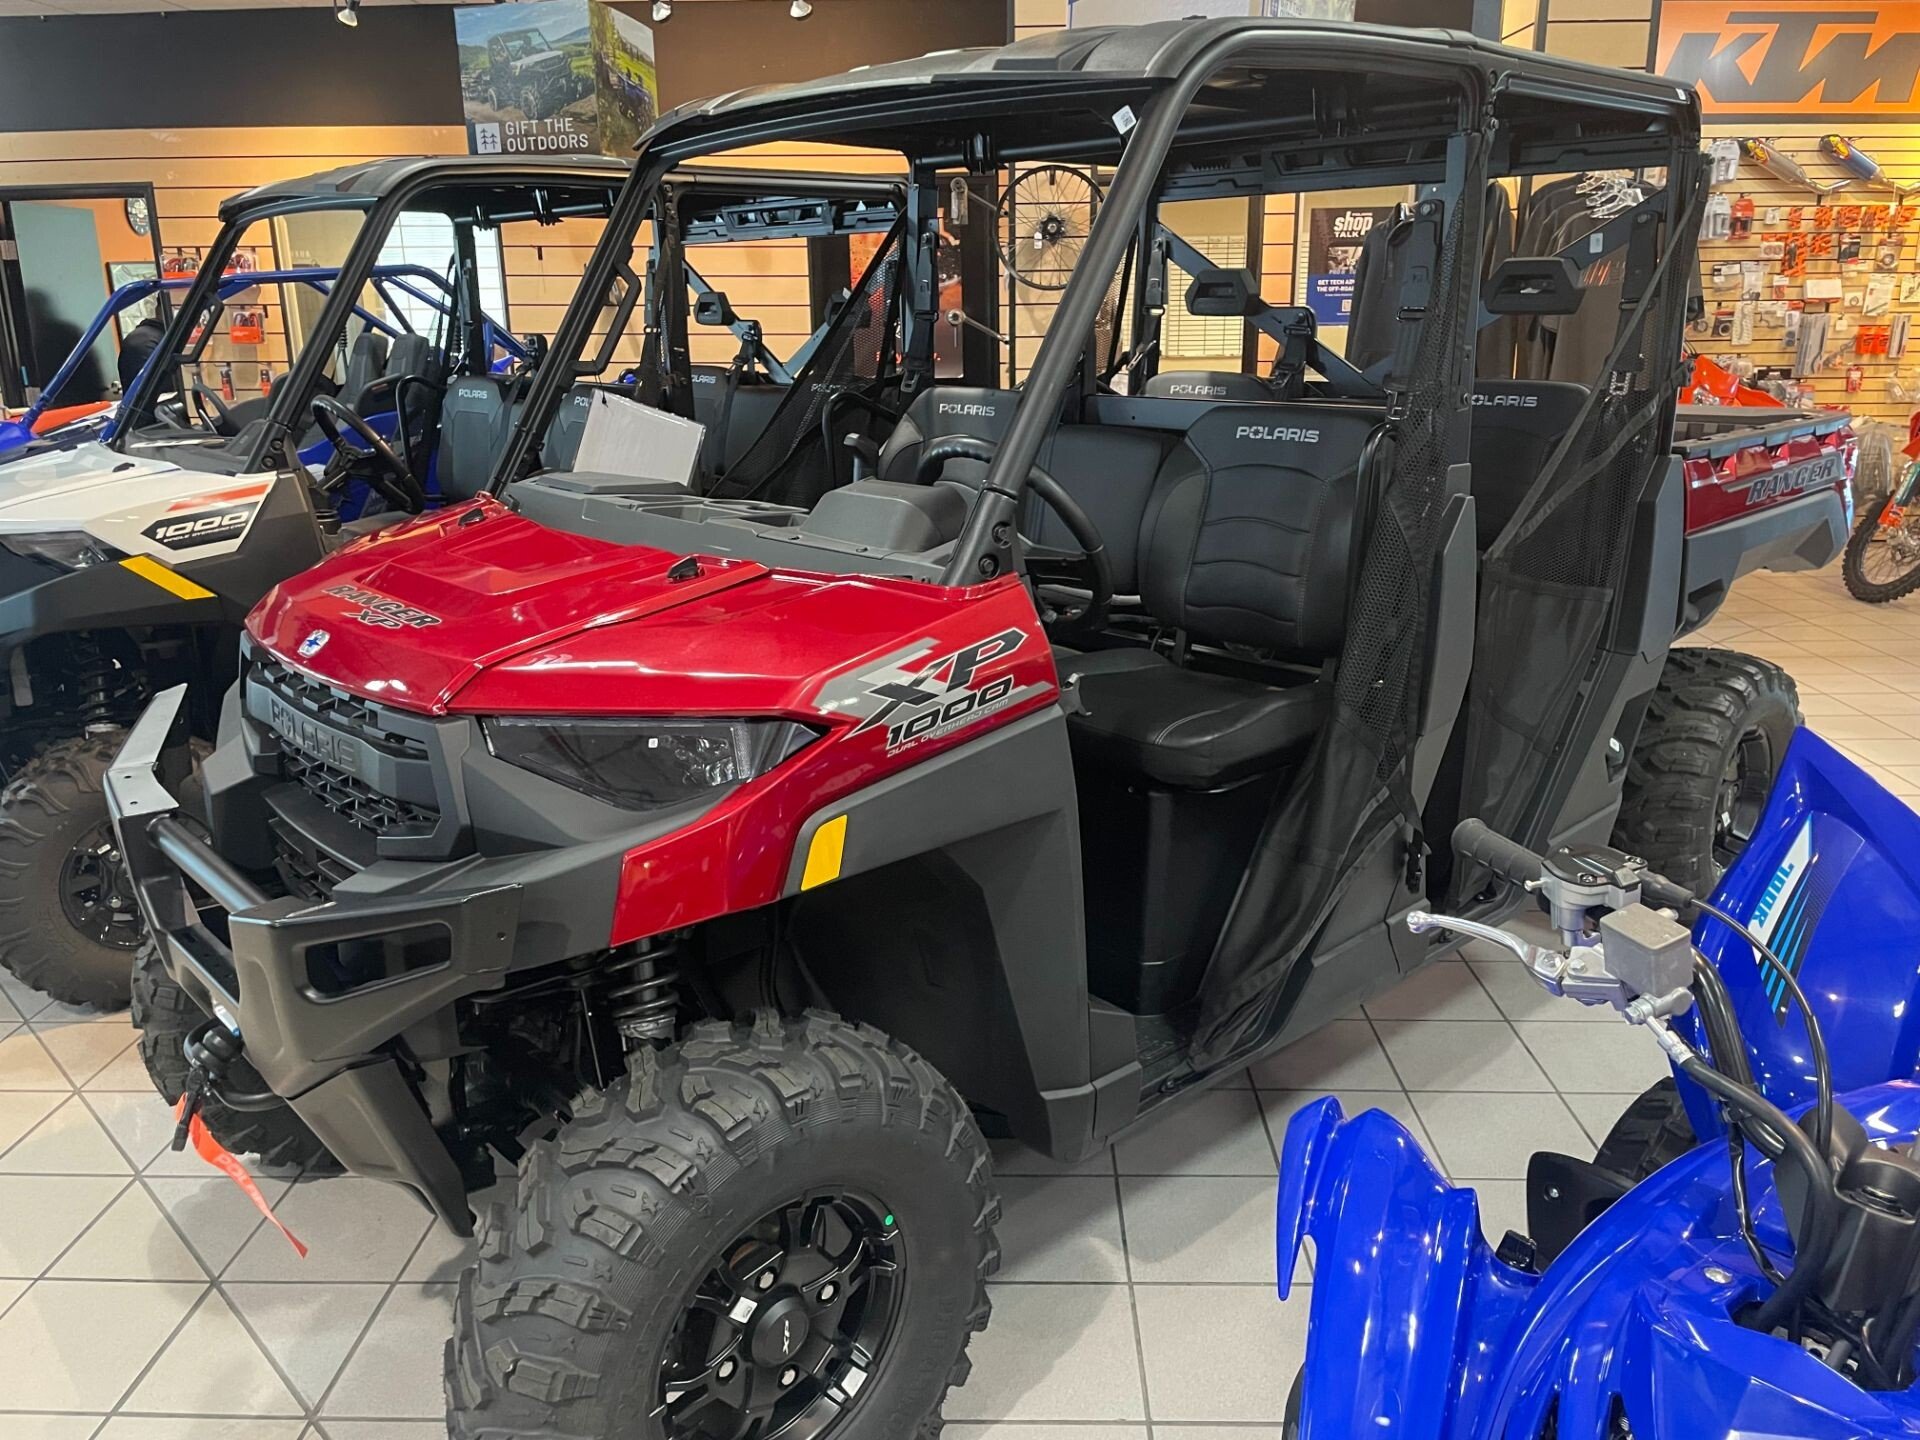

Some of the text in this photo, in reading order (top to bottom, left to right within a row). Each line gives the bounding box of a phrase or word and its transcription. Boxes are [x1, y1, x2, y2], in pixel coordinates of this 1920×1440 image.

[1663, 11, 1920, 103] KTM
[505, 118, 574, 136] GIFT THE
[506, 133, 589, 152] OUTDOORS
[1333, 211, 1373, 235] shop
[691, 376, 717, 384] OLARIS
[1169, 384, 1228, 396] POLARIS
[458, 388, 488, 399] POLARIS
[1471, 394, 1538, 407] OLARIS
[939, 403, 996, 417] POLARIS
[1235, 426, 1320, 443] POLARIS
[1746, 456, 1837, 505] RANGER
[155, 510, 249, 540] 1000
[321, 584, 442, 629] RANGER
[340, 608, 404, 629] XP
[838, 626, 1029, 743] XP
[885, 674, 1014, 750] 1000
[270, 697, 357, 773] POLARIS
[886, 699, 1010, 758] DUAL OVERHEAD CAM
[1751, 862, 1795, 929] 700R
